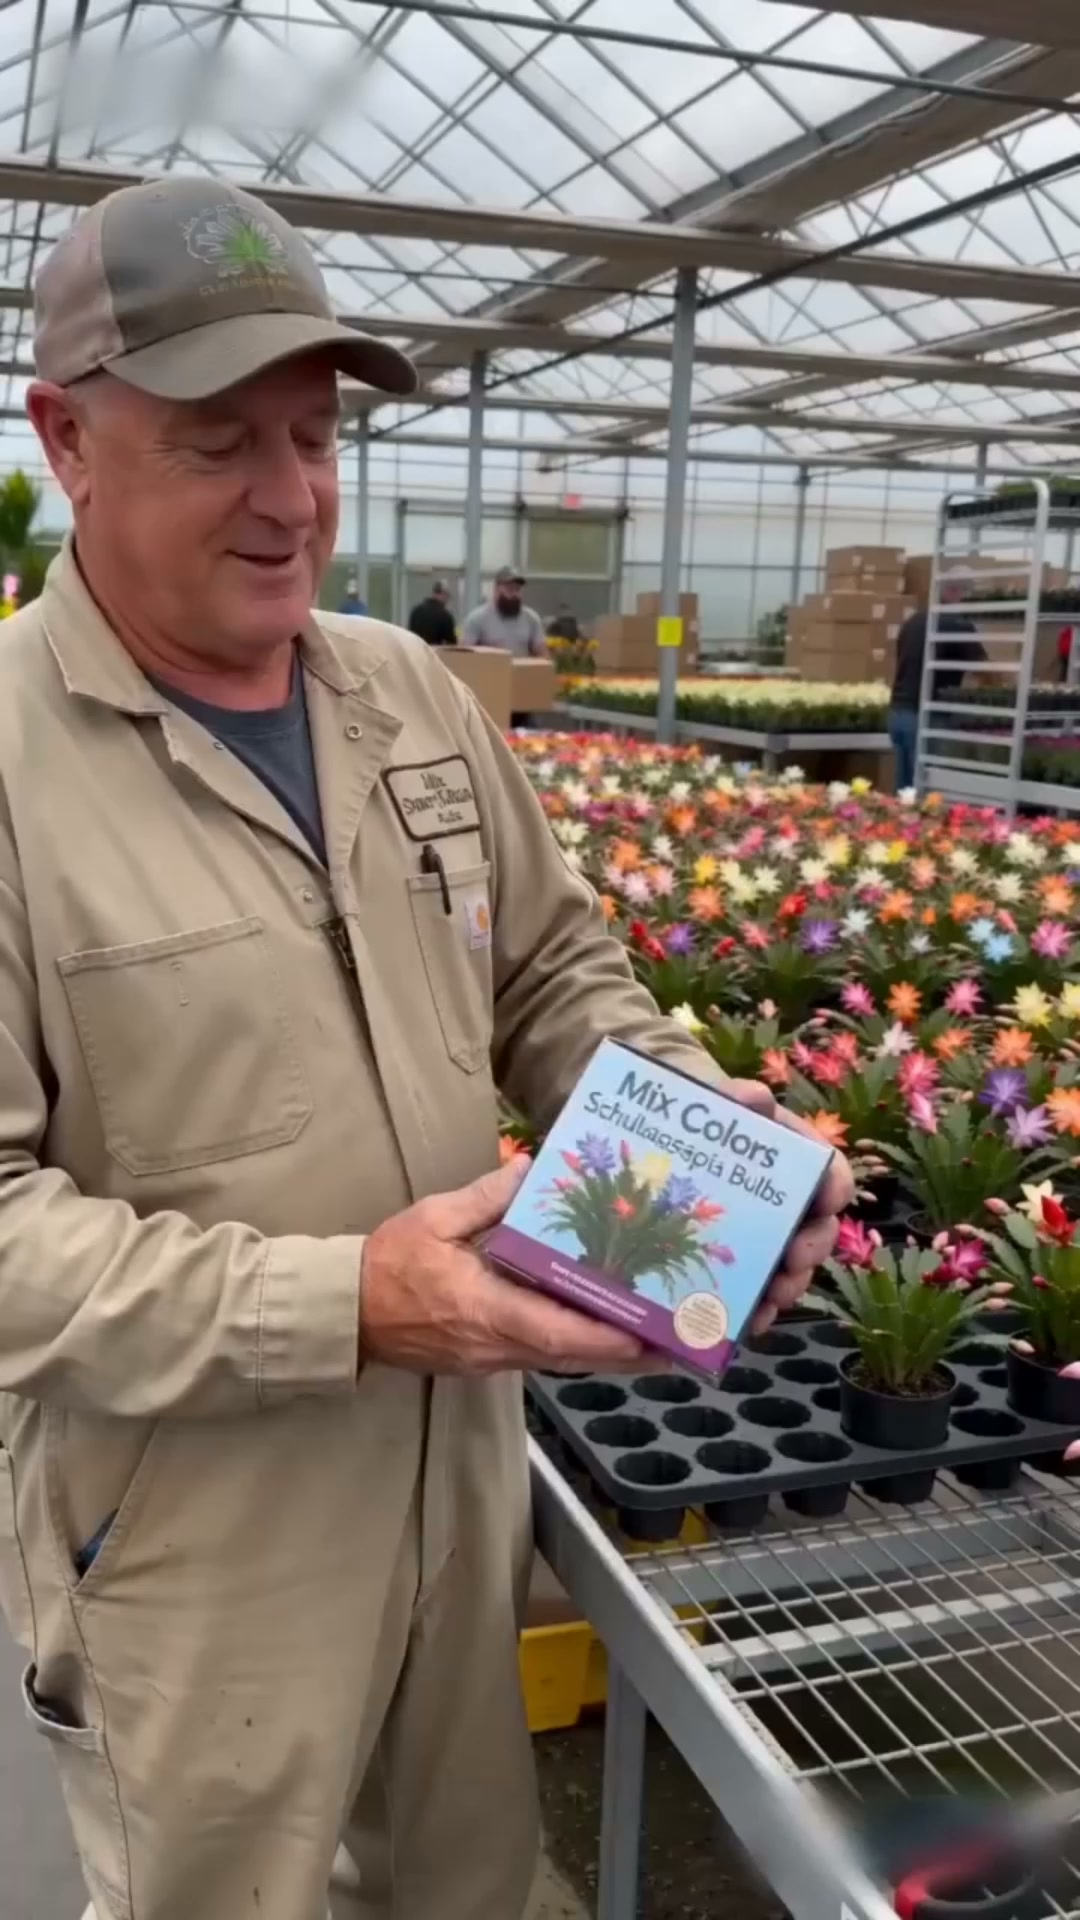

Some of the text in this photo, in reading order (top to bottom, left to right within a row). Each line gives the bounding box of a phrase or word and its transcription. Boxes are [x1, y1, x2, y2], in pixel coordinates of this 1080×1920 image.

[616, 1070, 780, 1169] Mix Colors
[728, 1163, 788, 1207] Bulbs
